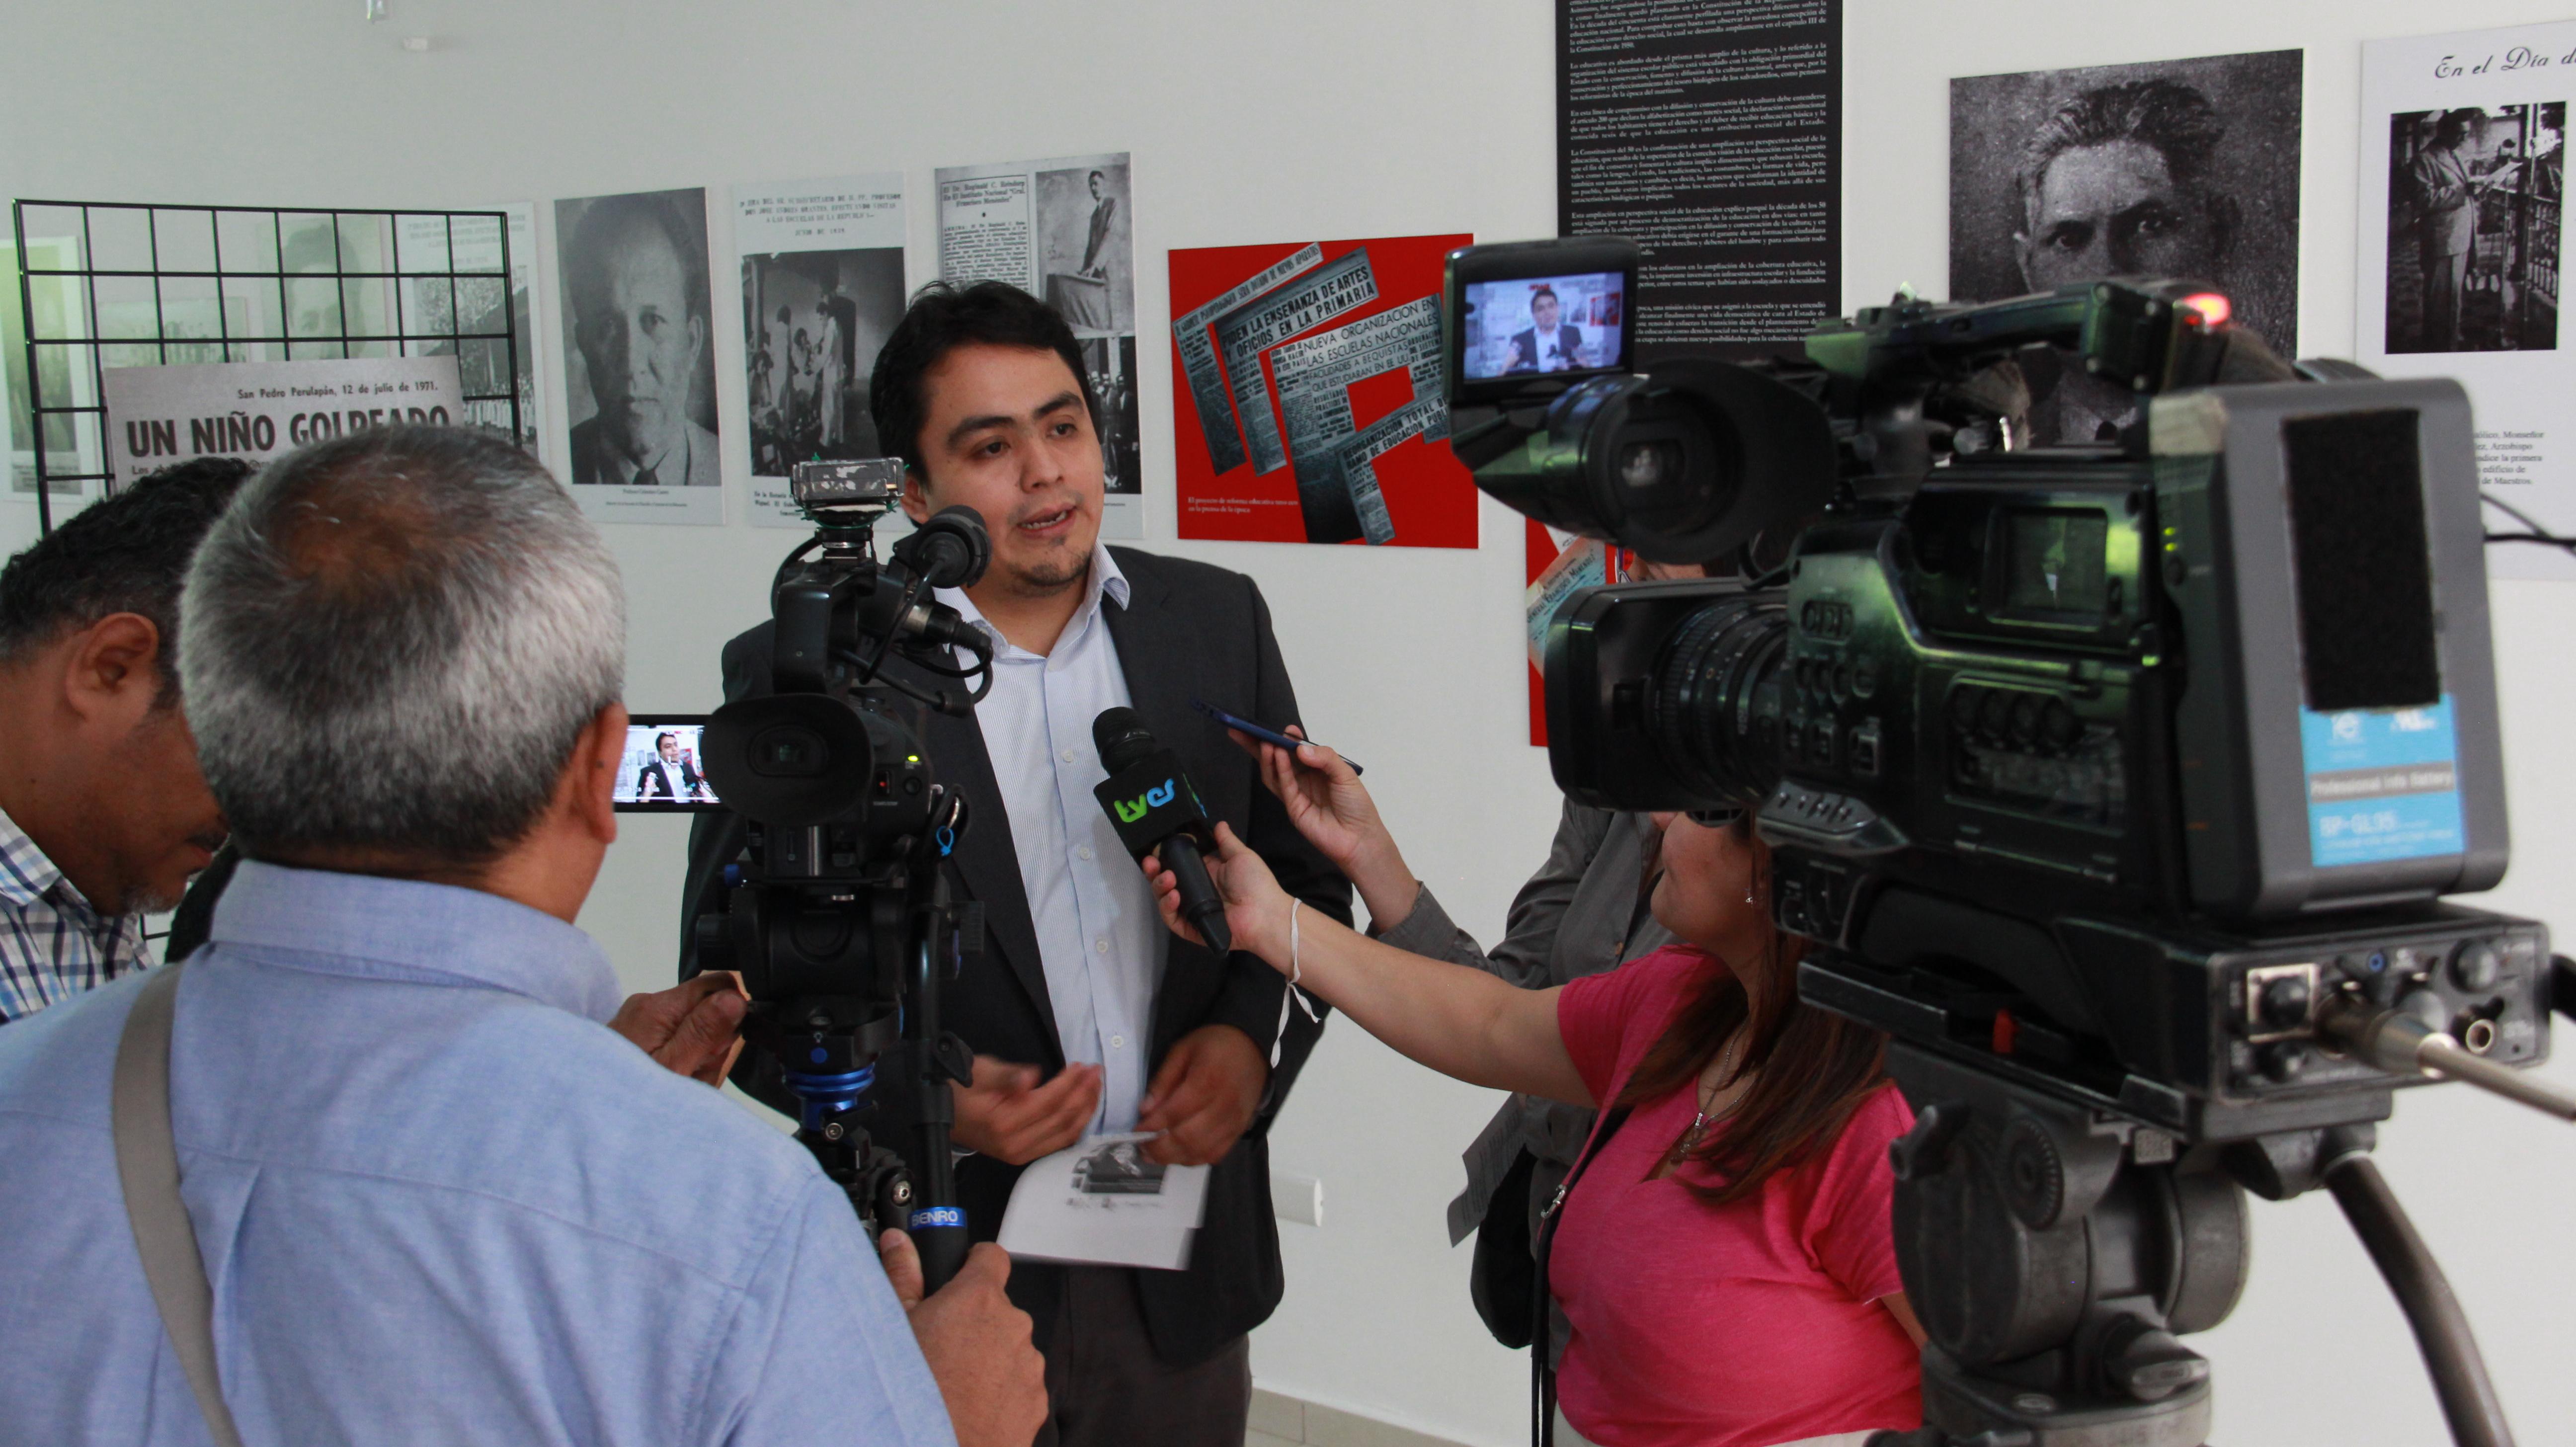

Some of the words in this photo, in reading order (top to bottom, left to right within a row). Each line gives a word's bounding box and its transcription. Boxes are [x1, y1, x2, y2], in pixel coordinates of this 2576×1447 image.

[2435, 55, 2464, 79] En
[2472, 55, 2494, 74] el
[2500, 47, 2549, 71] Día
[1221, 324, 1249, 349] PIDEN
[1250, 317, 1264, 333] LA
[1321, 280, 1336, 299] DE
[1337, 266, 1369, 293] ARTES
[1224, 350, 1232, 363] Y
[1237, 329, 1274, 358] OFICIOS
[1279, 320, 1292, 336] EN
[1297, 311, 1313, 328] LA
[1316, 282, 1375, 319] PRIMARIA
[1303, 333, 1337, 353] NUEVA
[1341, 305, 1419, 339] ORGANIZACION
[1422, 297, 1436, 312] EN
[1306, 353, 1324, 367] LAS
[1328, 337, 1373, 360] ESCUELAS
[1374, 312, 1439, 343] NACIONALES
[238, 389, 254, 400] San
[260, 388, 286, 399] Pedro
[291, 385, 337, 398] Perulapán,
[343, 384, 353, 395] 12
[358, 384, 369, 394] de
[375, 383, 394, 396] julio
[399, 382, 409, 392] de
[414, 381, 438, 392] 1971.
[1312, 380, 1328, 393] QUE
[1374, 361, 1385, 372] EN
[126, 419, 178, 458] UN
[191, 410, 276, 454] NIÑO
[1343, 418, 1404, 460] REORGANIZACION
[1406, 403, 1435, 423] TOTAL
[1370, 444, 1380, 457] DE
[1382, 420, 1425, 450] EDUCACION
[1427, 406, 1449, 425] PUBLI
[2490, 443, 2533, 452] Arzobispo
[2510, 455, 2543, 463] primera
[911, 1210, 959, 1227] BENRO
